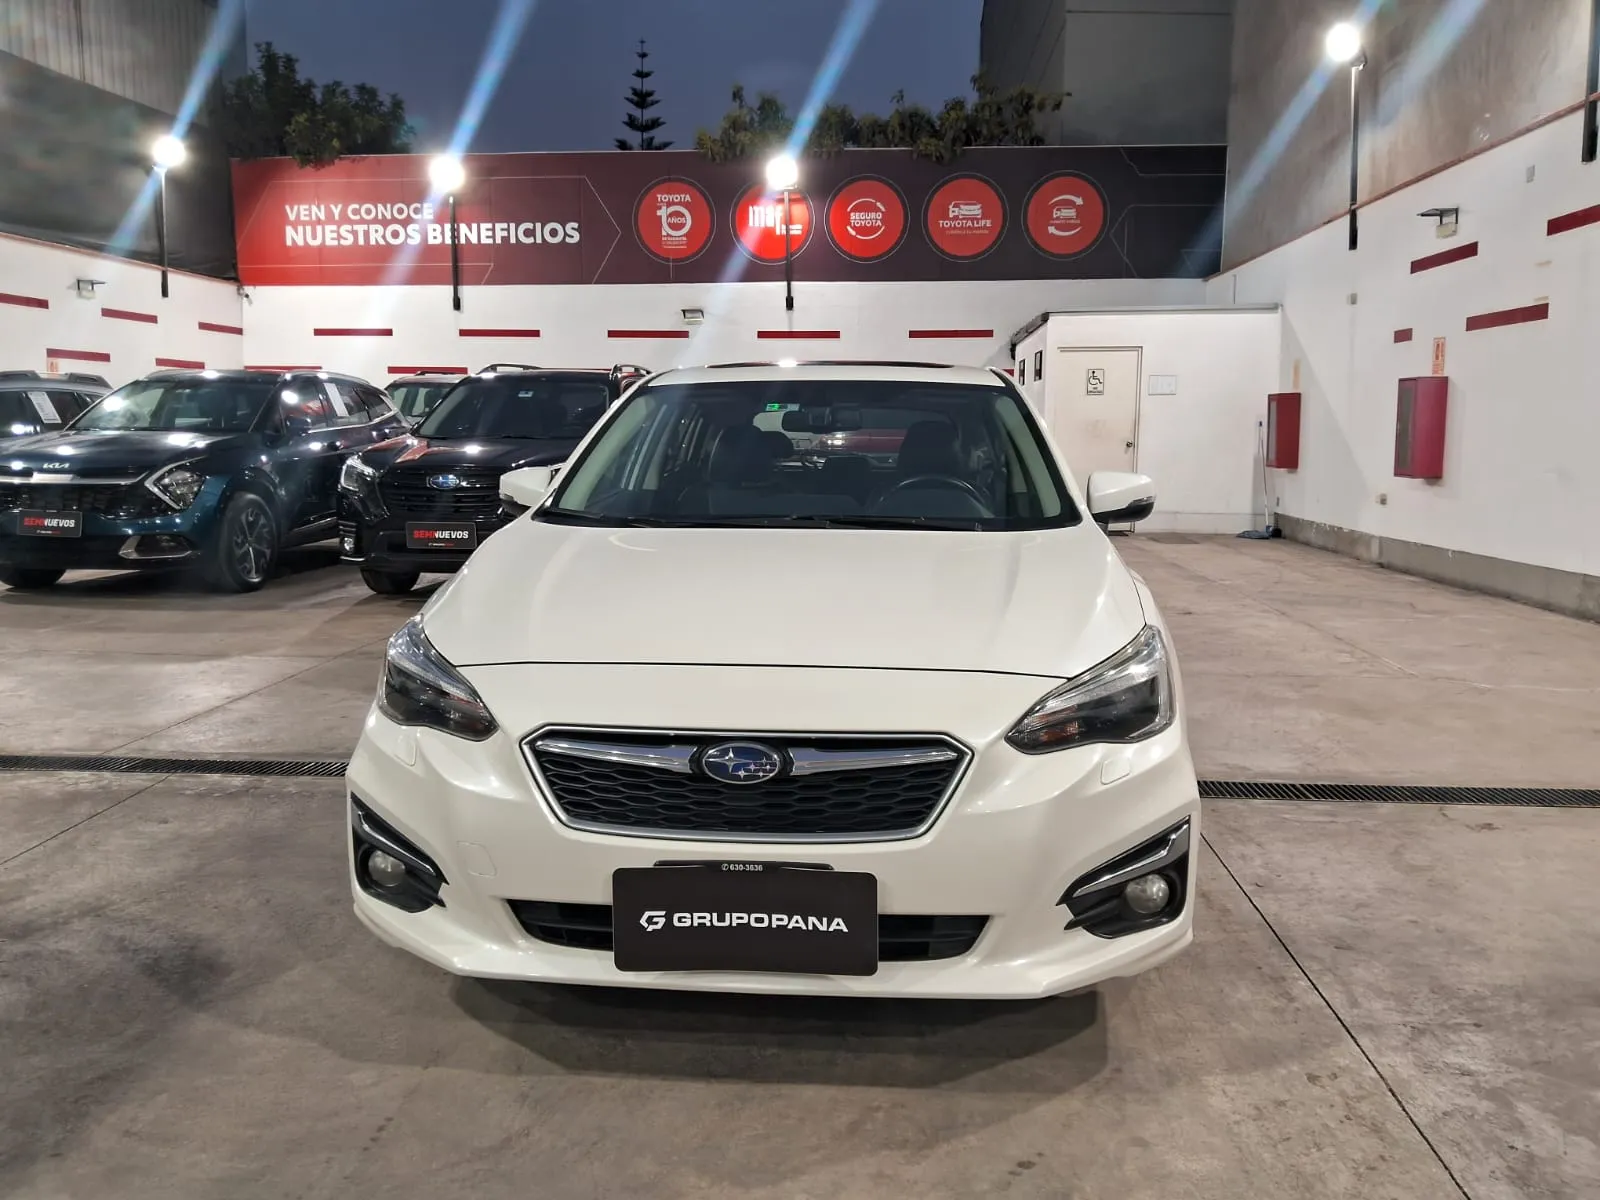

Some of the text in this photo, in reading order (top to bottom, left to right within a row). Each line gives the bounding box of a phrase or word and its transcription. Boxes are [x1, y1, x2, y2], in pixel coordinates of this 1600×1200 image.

[656, 194, 691, 202] TOYOTA
[285, 203, 434, 221] VEN Y CONOCE
[850, 212, 882, 220] SEGURO
[850, 219, 882, 227] TOYOTA
[938, 219, 992, 228] TOYOTA LIFE
[285, 222, 580, 246] NUESTROS BENEFICIOS
[672, 912, 848, 932] GRUPOPANA
